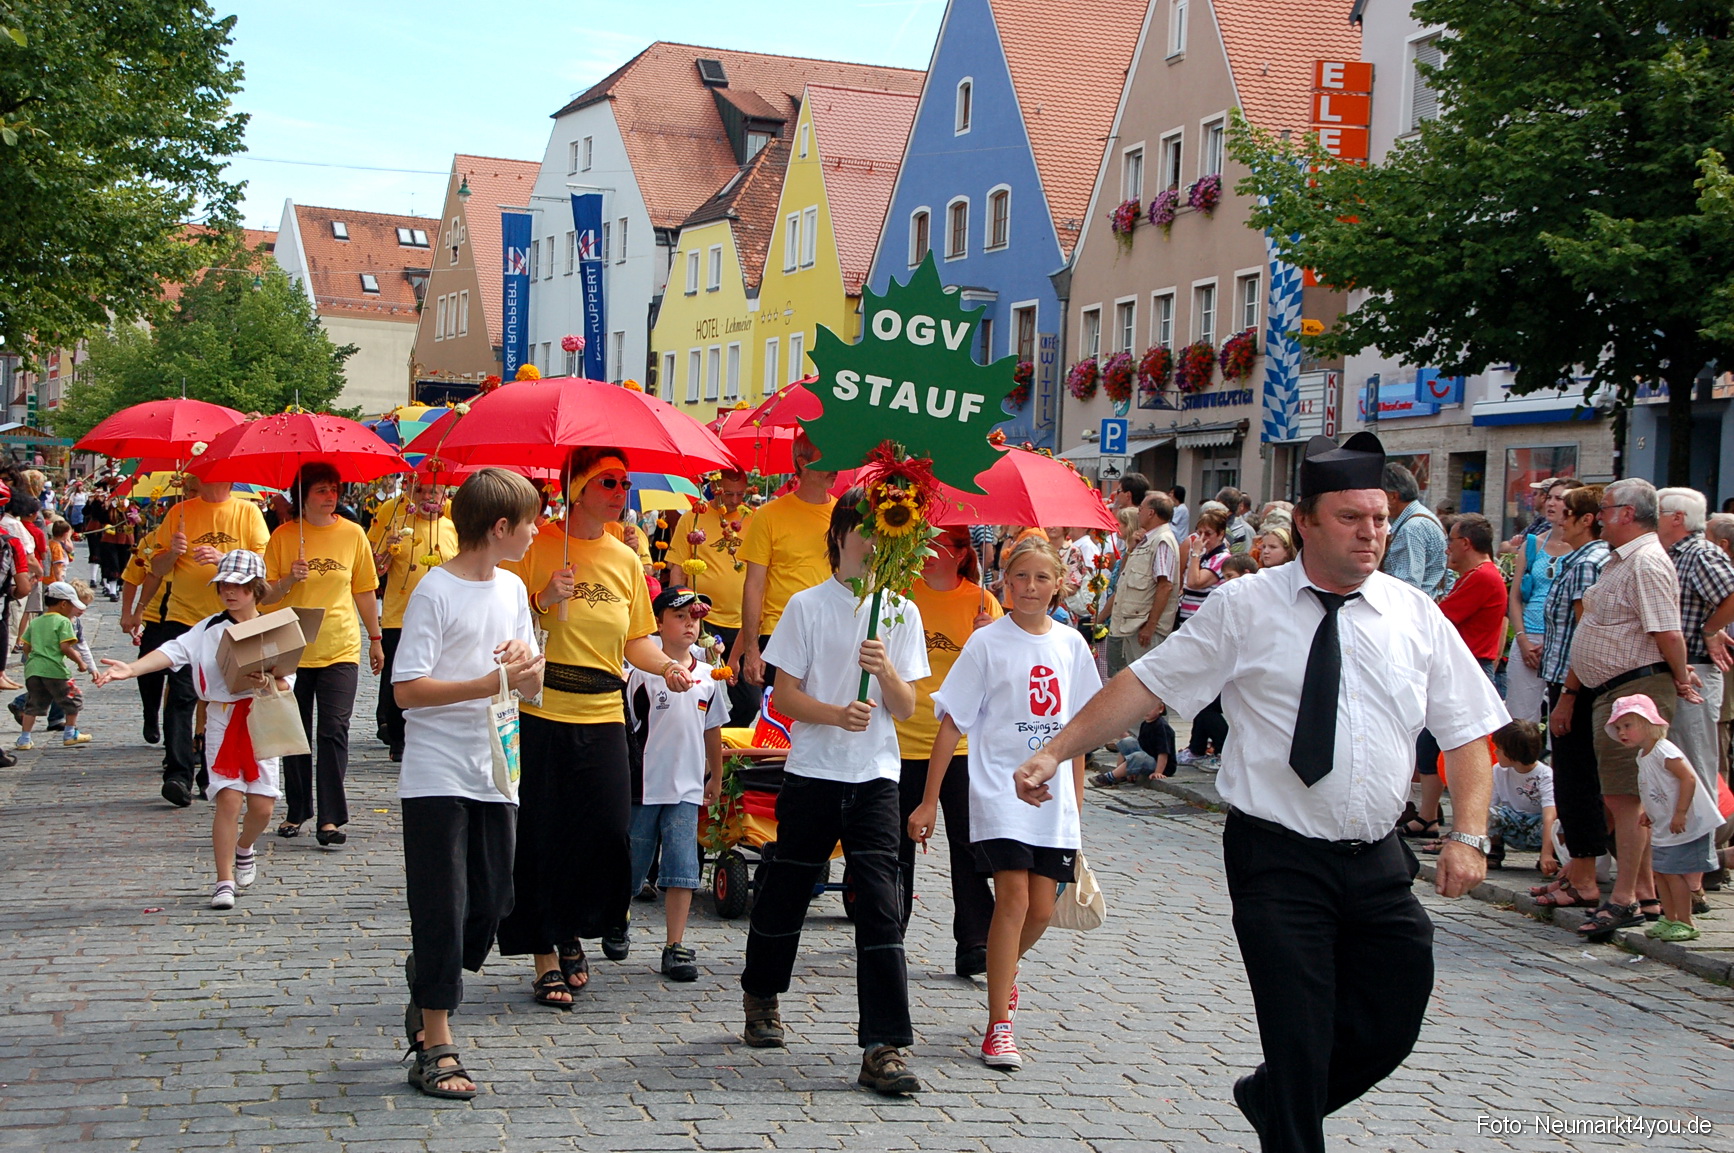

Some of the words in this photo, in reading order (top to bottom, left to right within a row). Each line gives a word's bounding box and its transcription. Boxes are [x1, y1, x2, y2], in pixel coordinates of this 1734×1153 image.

[696, 318, 719, 340] HOTEL
[872, 309, 970, 351] OGV
[832, 370, 985, 422] STAUF
[1040, 352, 1054, 421] WITTL
[1325, 374, 1337, 437] KINO
[1106, 423, 1121, 449] P
[1014, 721, 1051, 735] Beijing
